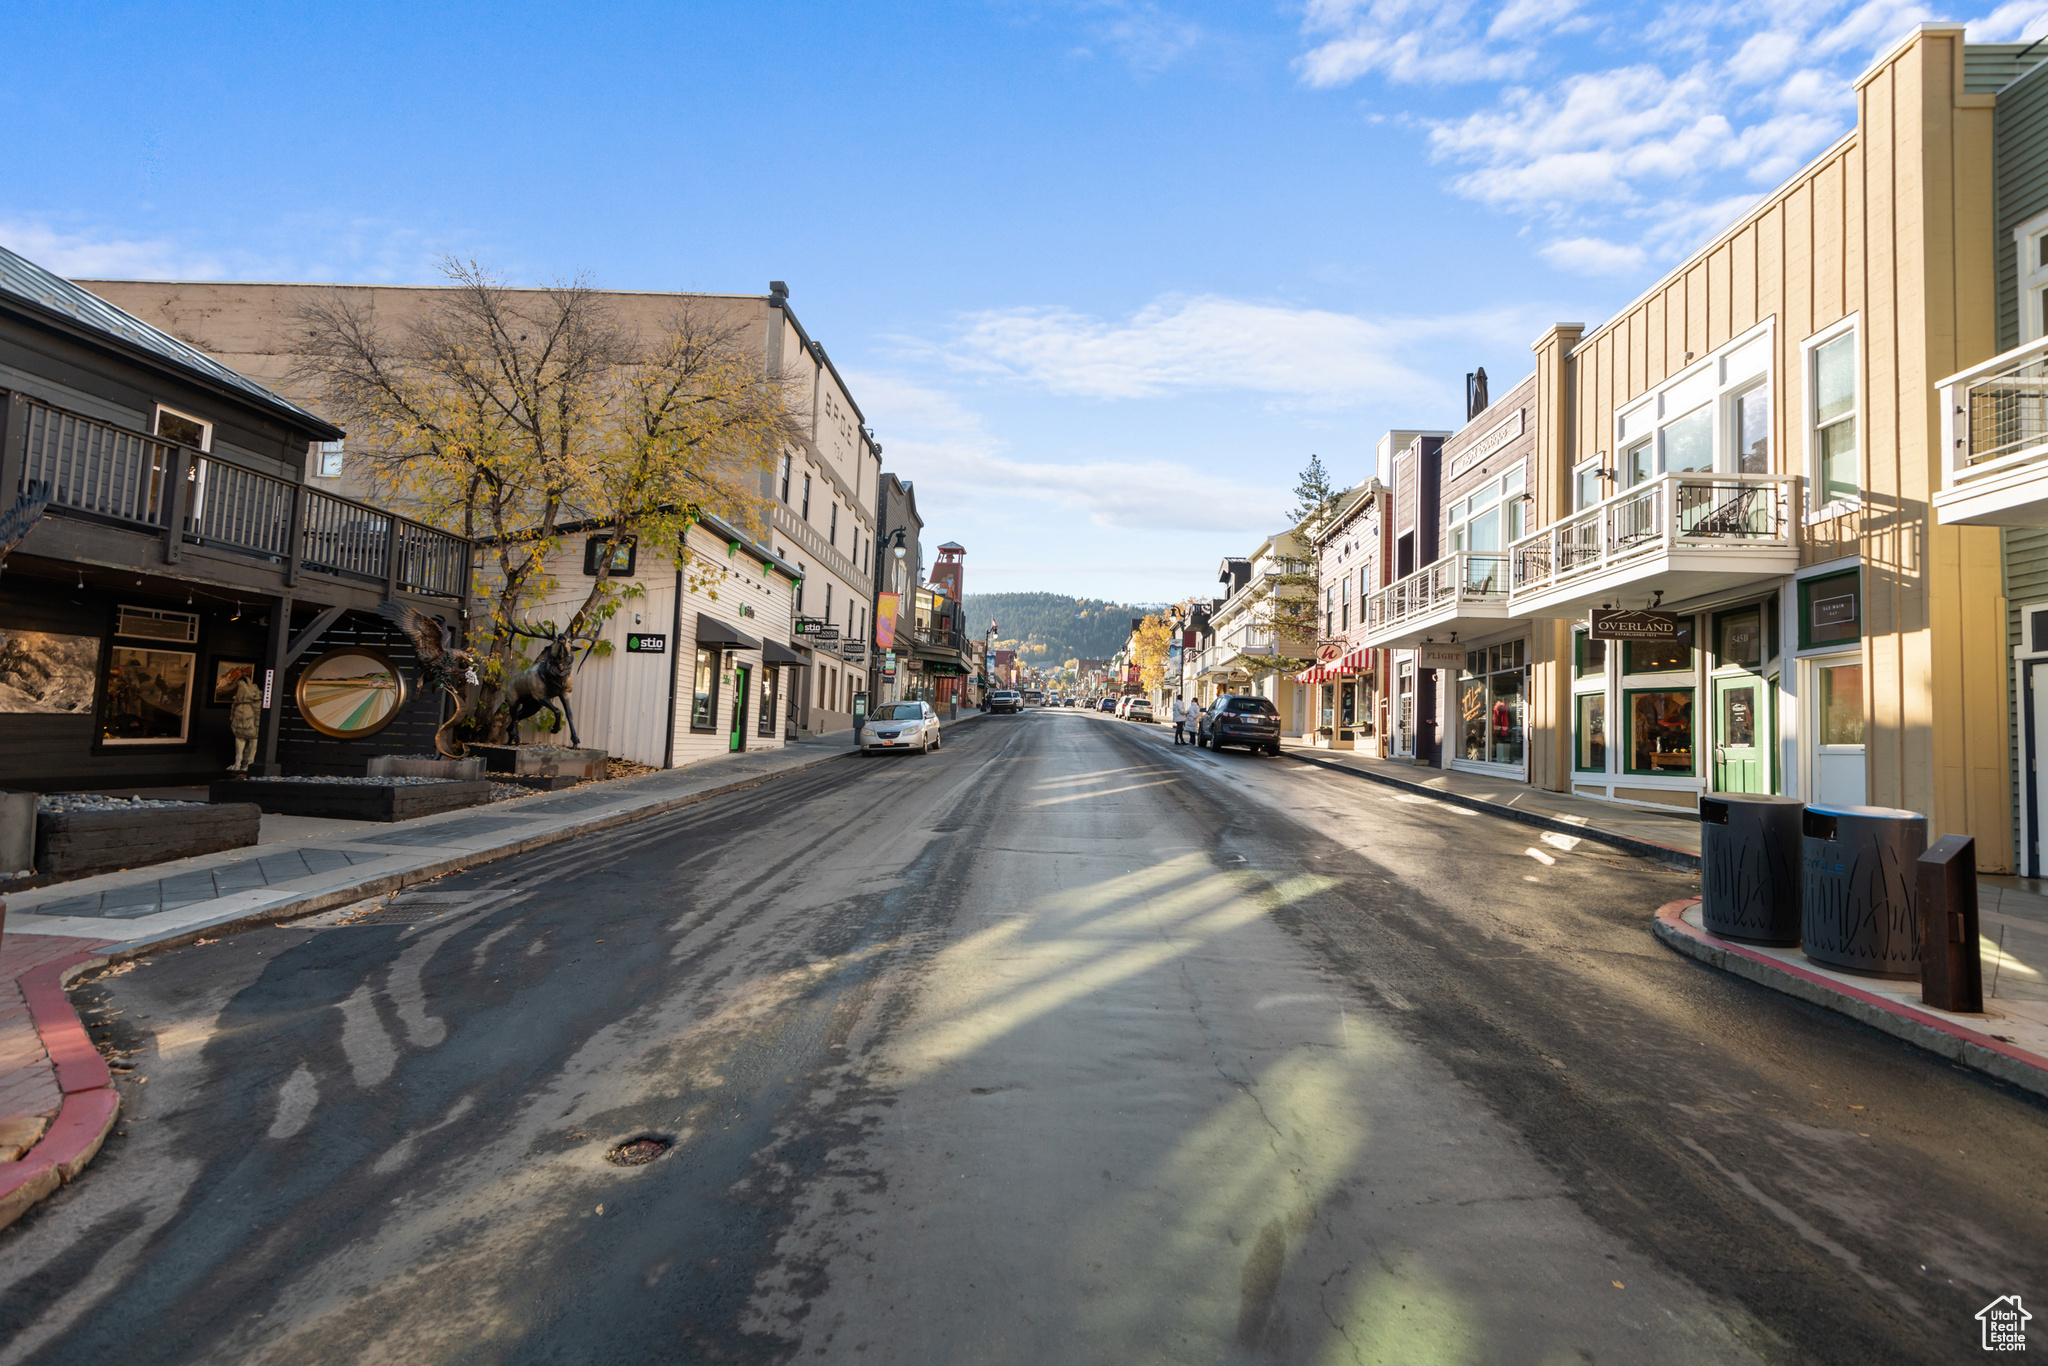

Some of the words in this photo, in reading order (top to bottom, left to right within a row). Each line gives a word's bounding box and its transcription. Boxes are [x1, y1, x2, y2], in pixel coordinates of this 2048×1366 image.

[804, 623, 821, 631] stio
[1598, 621, 1674, 632] OVERLAND
[640, 637, 663, 648] stio
[1732, 633, 1749, 644] 545B
[1426, 652, 1461, 661] FLIGHT
